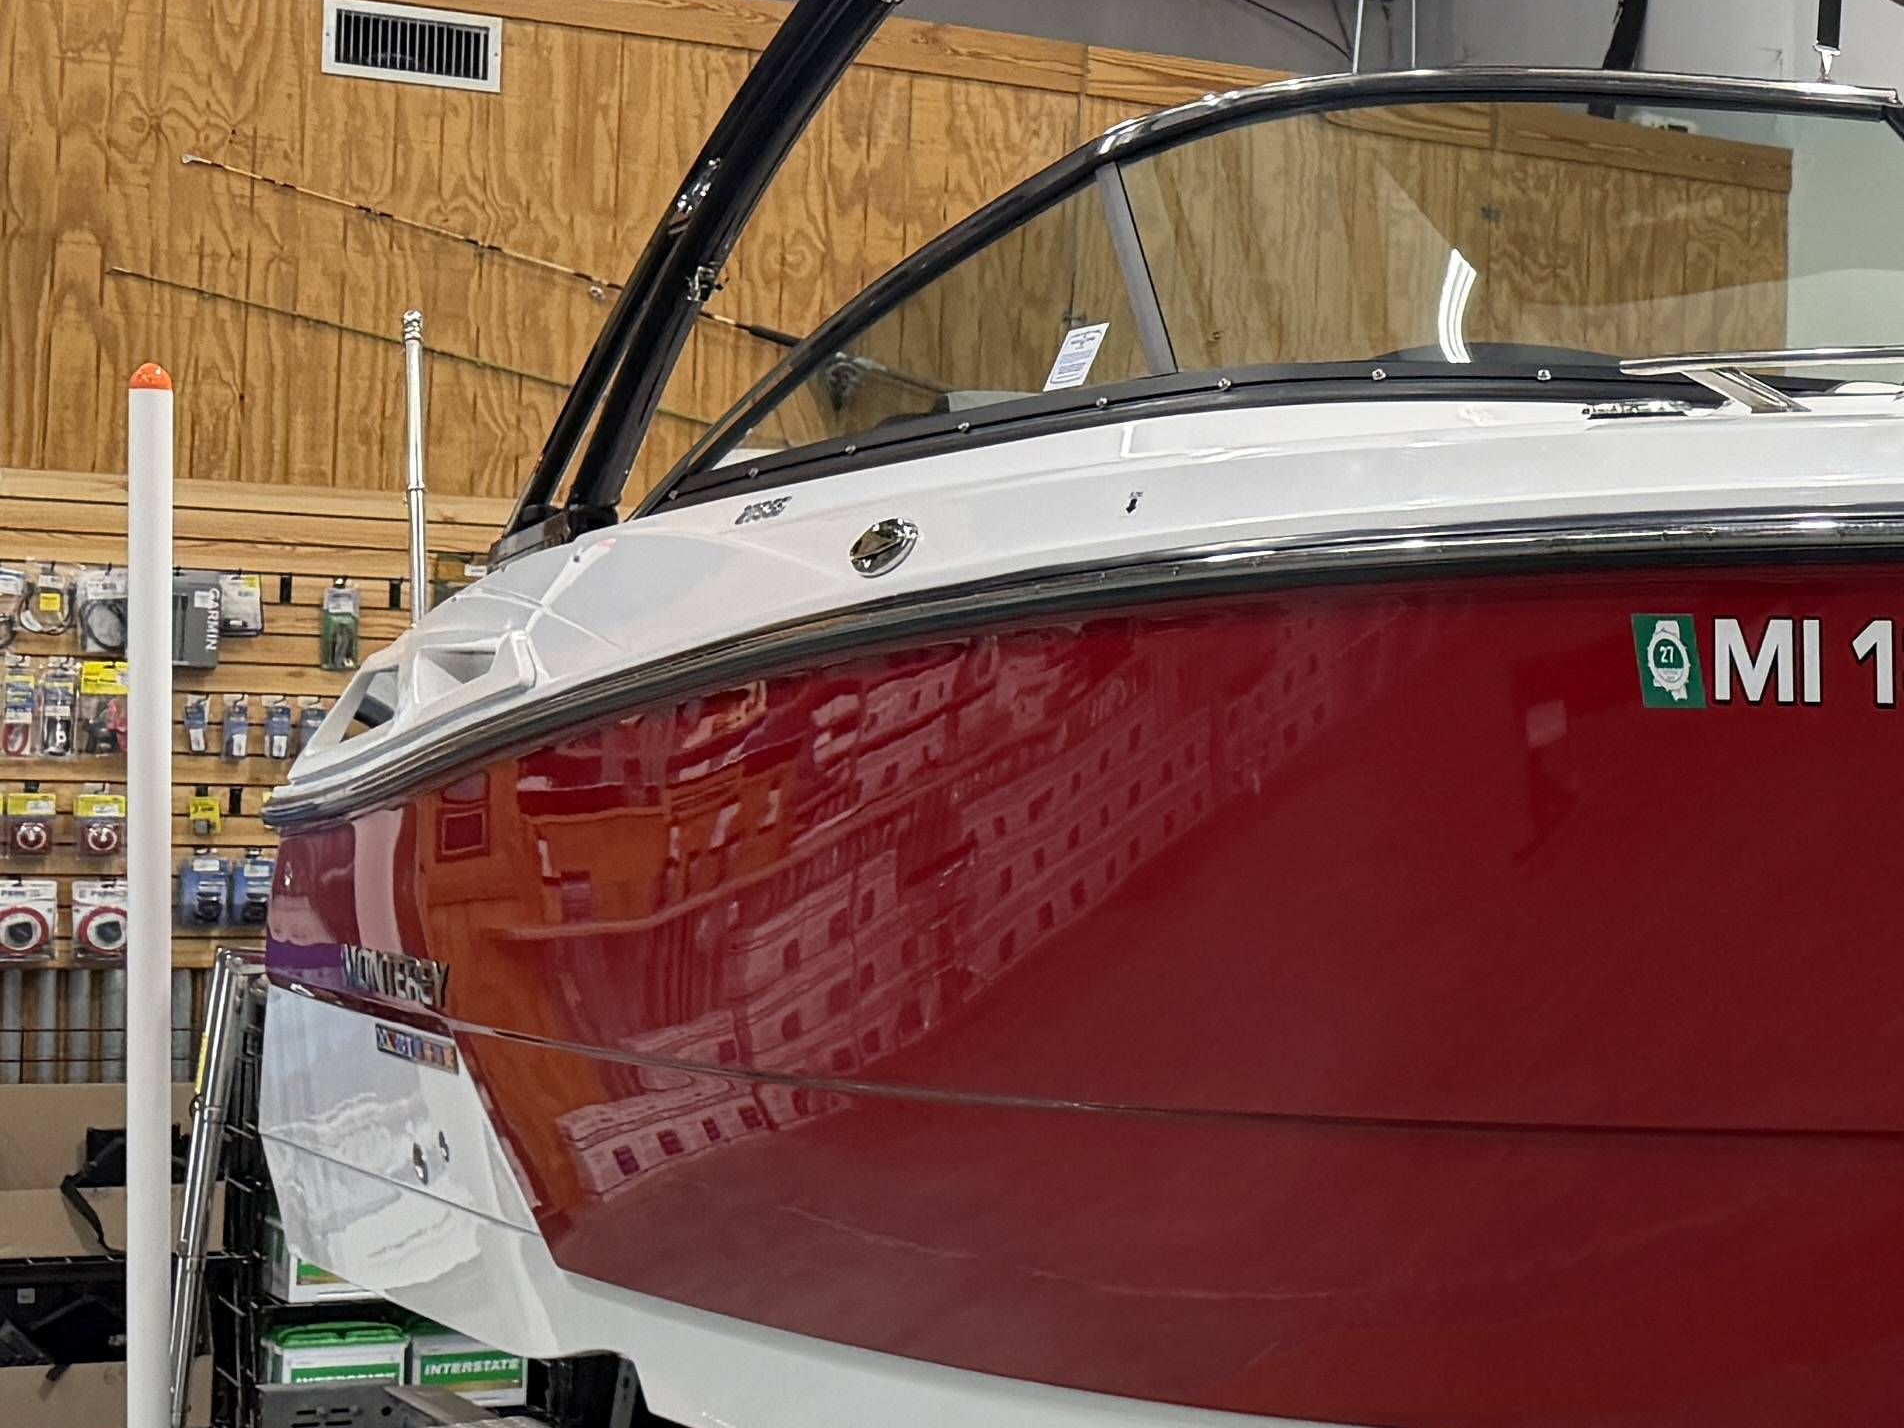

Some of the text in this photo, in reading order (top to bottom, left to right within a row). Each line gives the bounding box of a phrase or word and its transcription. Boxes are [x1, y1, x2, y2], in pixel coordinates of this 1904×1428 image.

[205, 587, 220, 651] GARMIN
[1659, 645, 1675, 664] 27
[1712, 617, 1823, 704] MI
[341, 943, 450, 1009] MONTEREY
[424, 1357, 521, 1376] INTERSTATE
